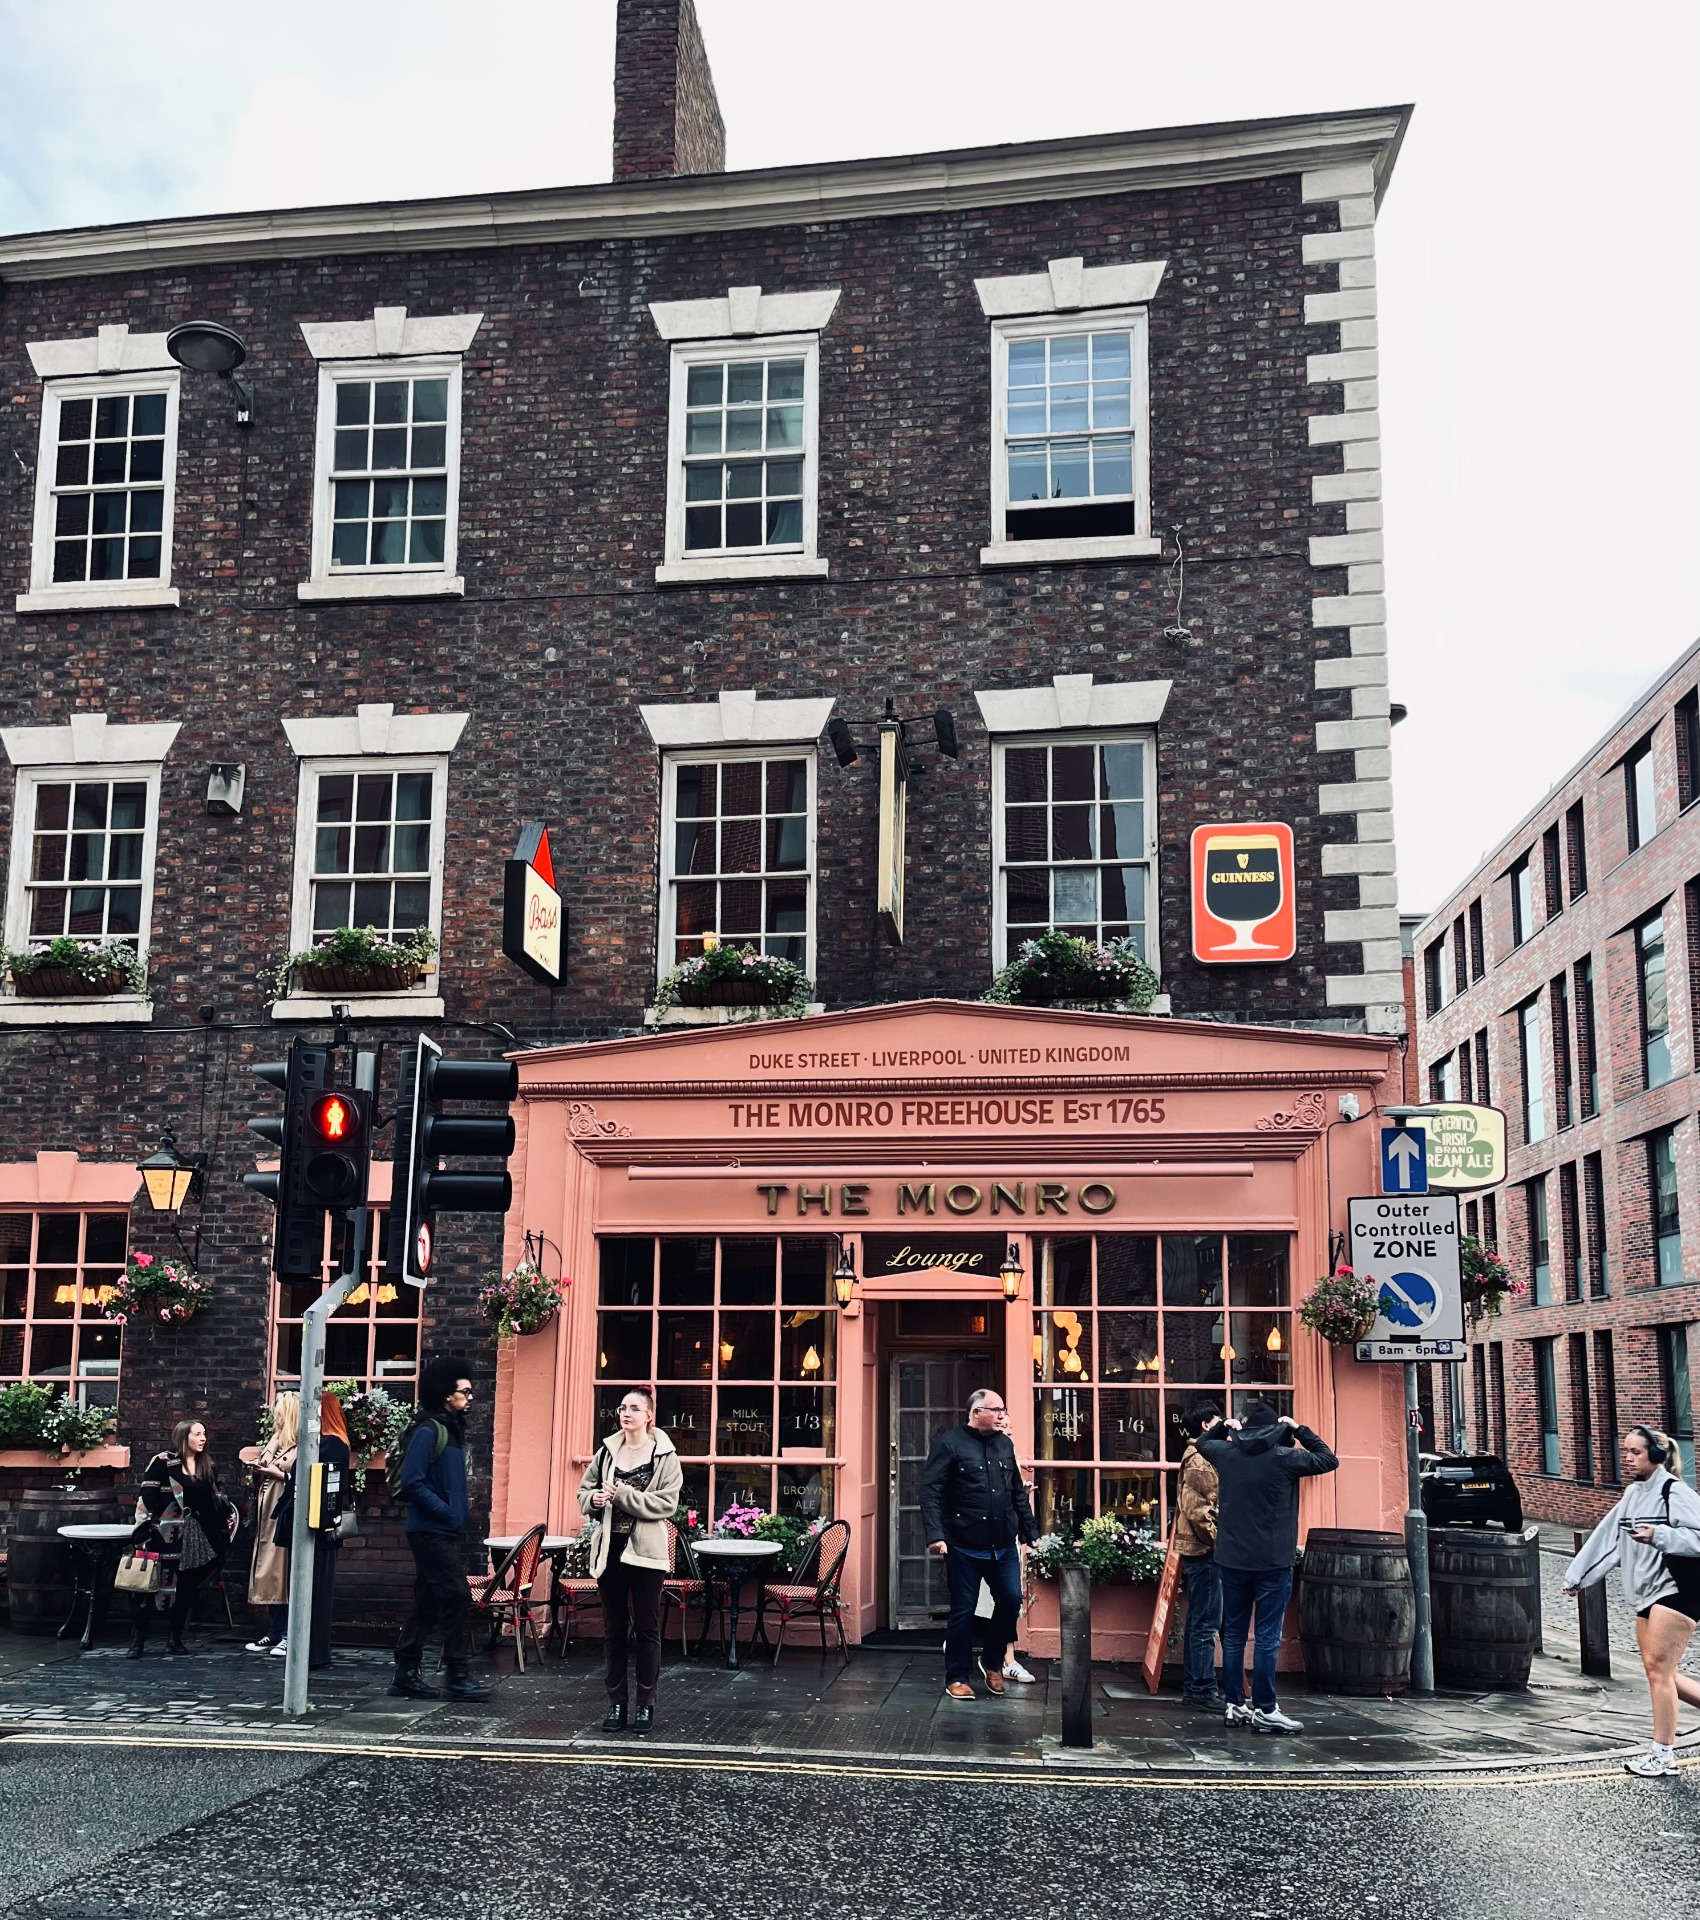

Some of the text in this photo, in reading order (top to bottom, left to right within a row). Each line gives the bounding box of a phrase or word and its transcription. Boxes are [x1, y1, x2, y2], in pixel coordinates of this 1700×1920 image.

[1211, 871, 1275, 884] GUINNESS
[529, 893, 558, 931] Bass
[749, 1046, 1130, 1069] DUKE STREET LIVERPOOL UNITED KINGDOM
[729, 1103, 780, 1128] THE
[788, 1101, 894, 1127] MONRO
[901, 1100, 1054, 1126] FREEHOUSE
[1106, 1098, 1166, 1124] 1765
[1441, 1132, 1467, 1146] IRISH
[1434, 1146, 1474, 1154] BRAND
[1426, 1153, 1493, 1168] REAM ALE
[757, 1181, 1118, 1217] THE MONRO
[1376, 1203, 1430, 1218] Outer
[1354, 1220, 1455, 1238] Controlled
[1373, 1240, 1437, 1259] ZONE
[886, 1246, 984, 1271] Lounge
[1378, 1345, 1404, 1355] 8am
[732, 1408, 759, 1419] MILK
[1043, 1413, 1084, 1423] CREAM
[726, 1422, 764, 1432] STOUT
[794, 1413, 820, 1430] 1/3
[1116, 1416, 1144, 1434] 1/6
[783, 1485, 828, 1496] BROWN
[795, 1500, 816, 1510] ALE
